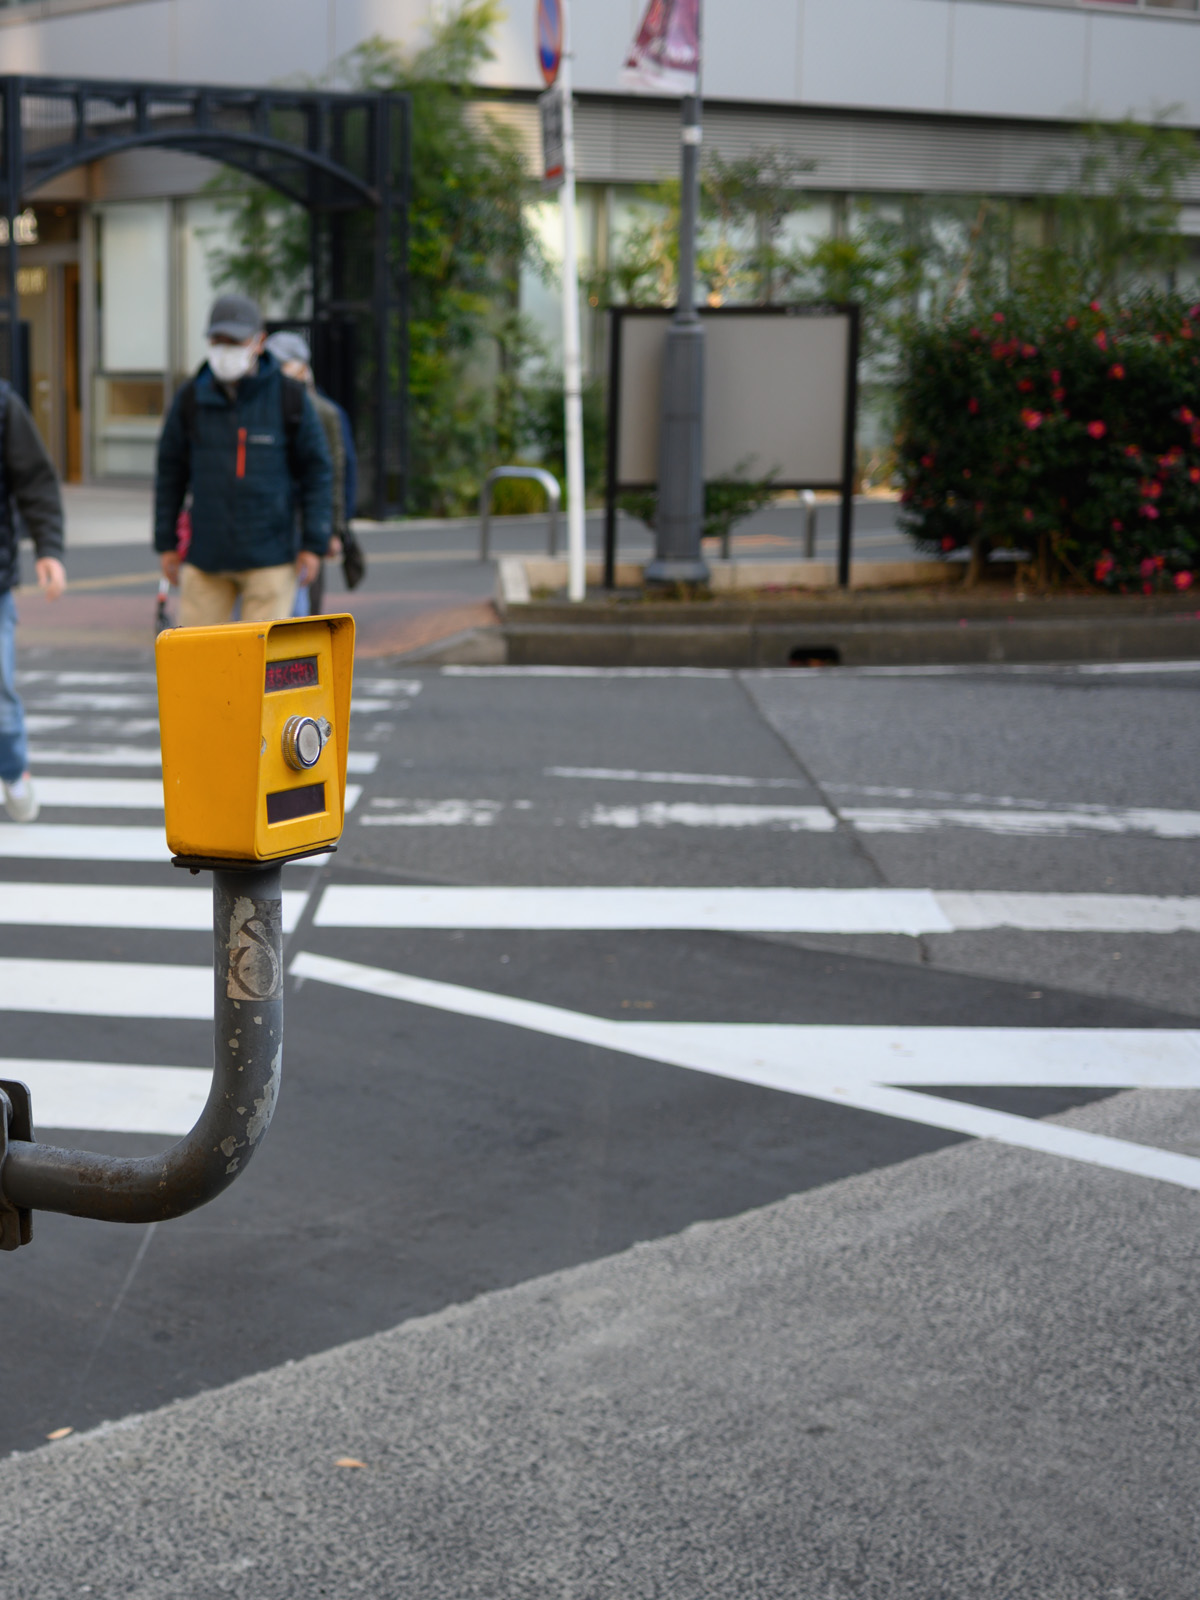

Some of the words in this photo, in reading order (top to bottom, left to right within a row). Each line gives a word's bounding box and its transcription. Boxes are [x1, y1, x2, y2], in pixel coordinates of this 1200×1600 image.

[265, 662, 315, 688] まちください
